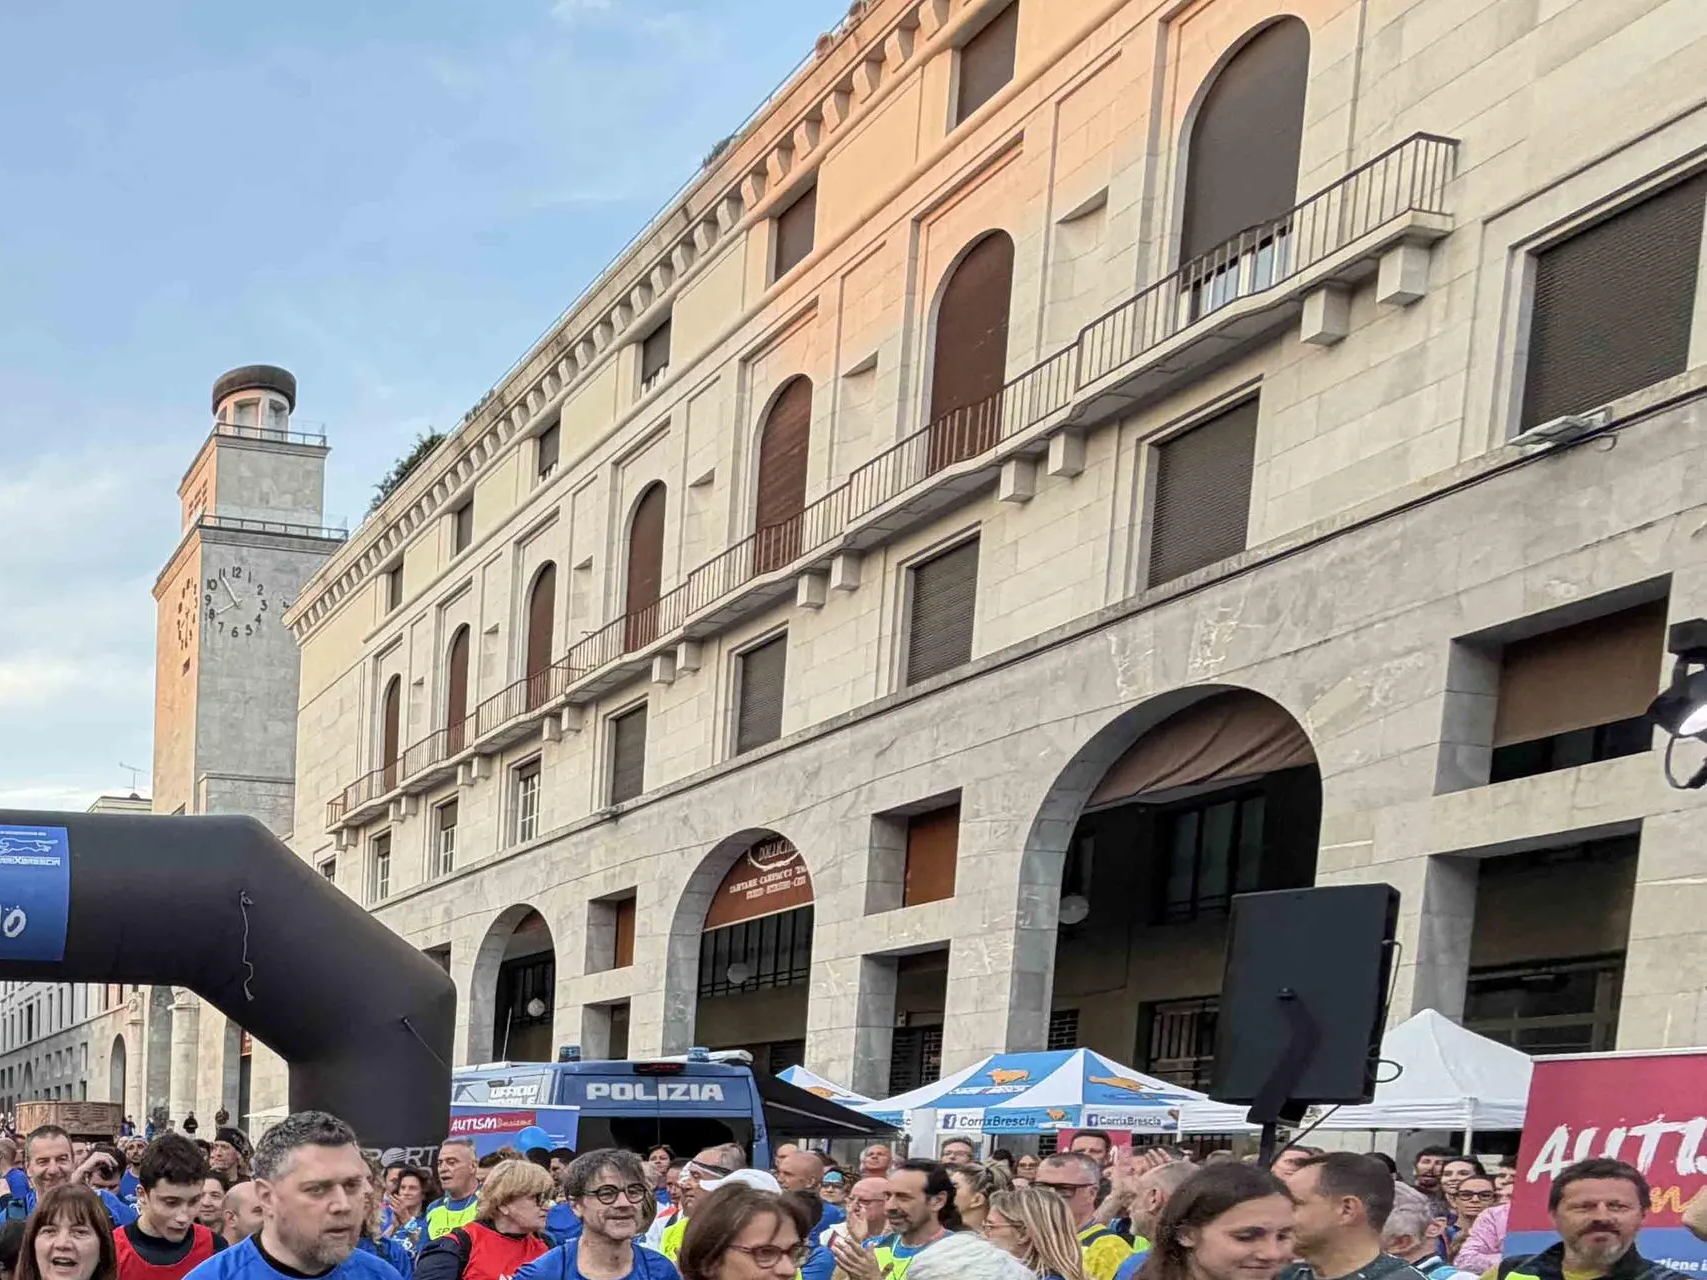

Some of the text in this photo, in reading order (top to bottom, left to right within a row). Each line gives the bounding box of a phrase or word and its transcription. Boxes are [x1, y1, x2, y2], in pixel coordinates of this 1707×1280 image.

[232, 566, 242, 578] 12
[206, 579, 217, 590] 10
[256, 583, 264, 596] 2
[205, 594, 212, 606] 9
[260, 599, 268, 611] 3
[254, 613, 261, 626] 4
[218, 621, 225, 635] 7
[231, 626, 239, 638] 6
[245, 624, 253, 636] 5
[585, 1082, 725, 1101] POLIZIA
[1526, 1116, 1707, 1183] AUTI
[361, 1146, 439, 1167] PORT
